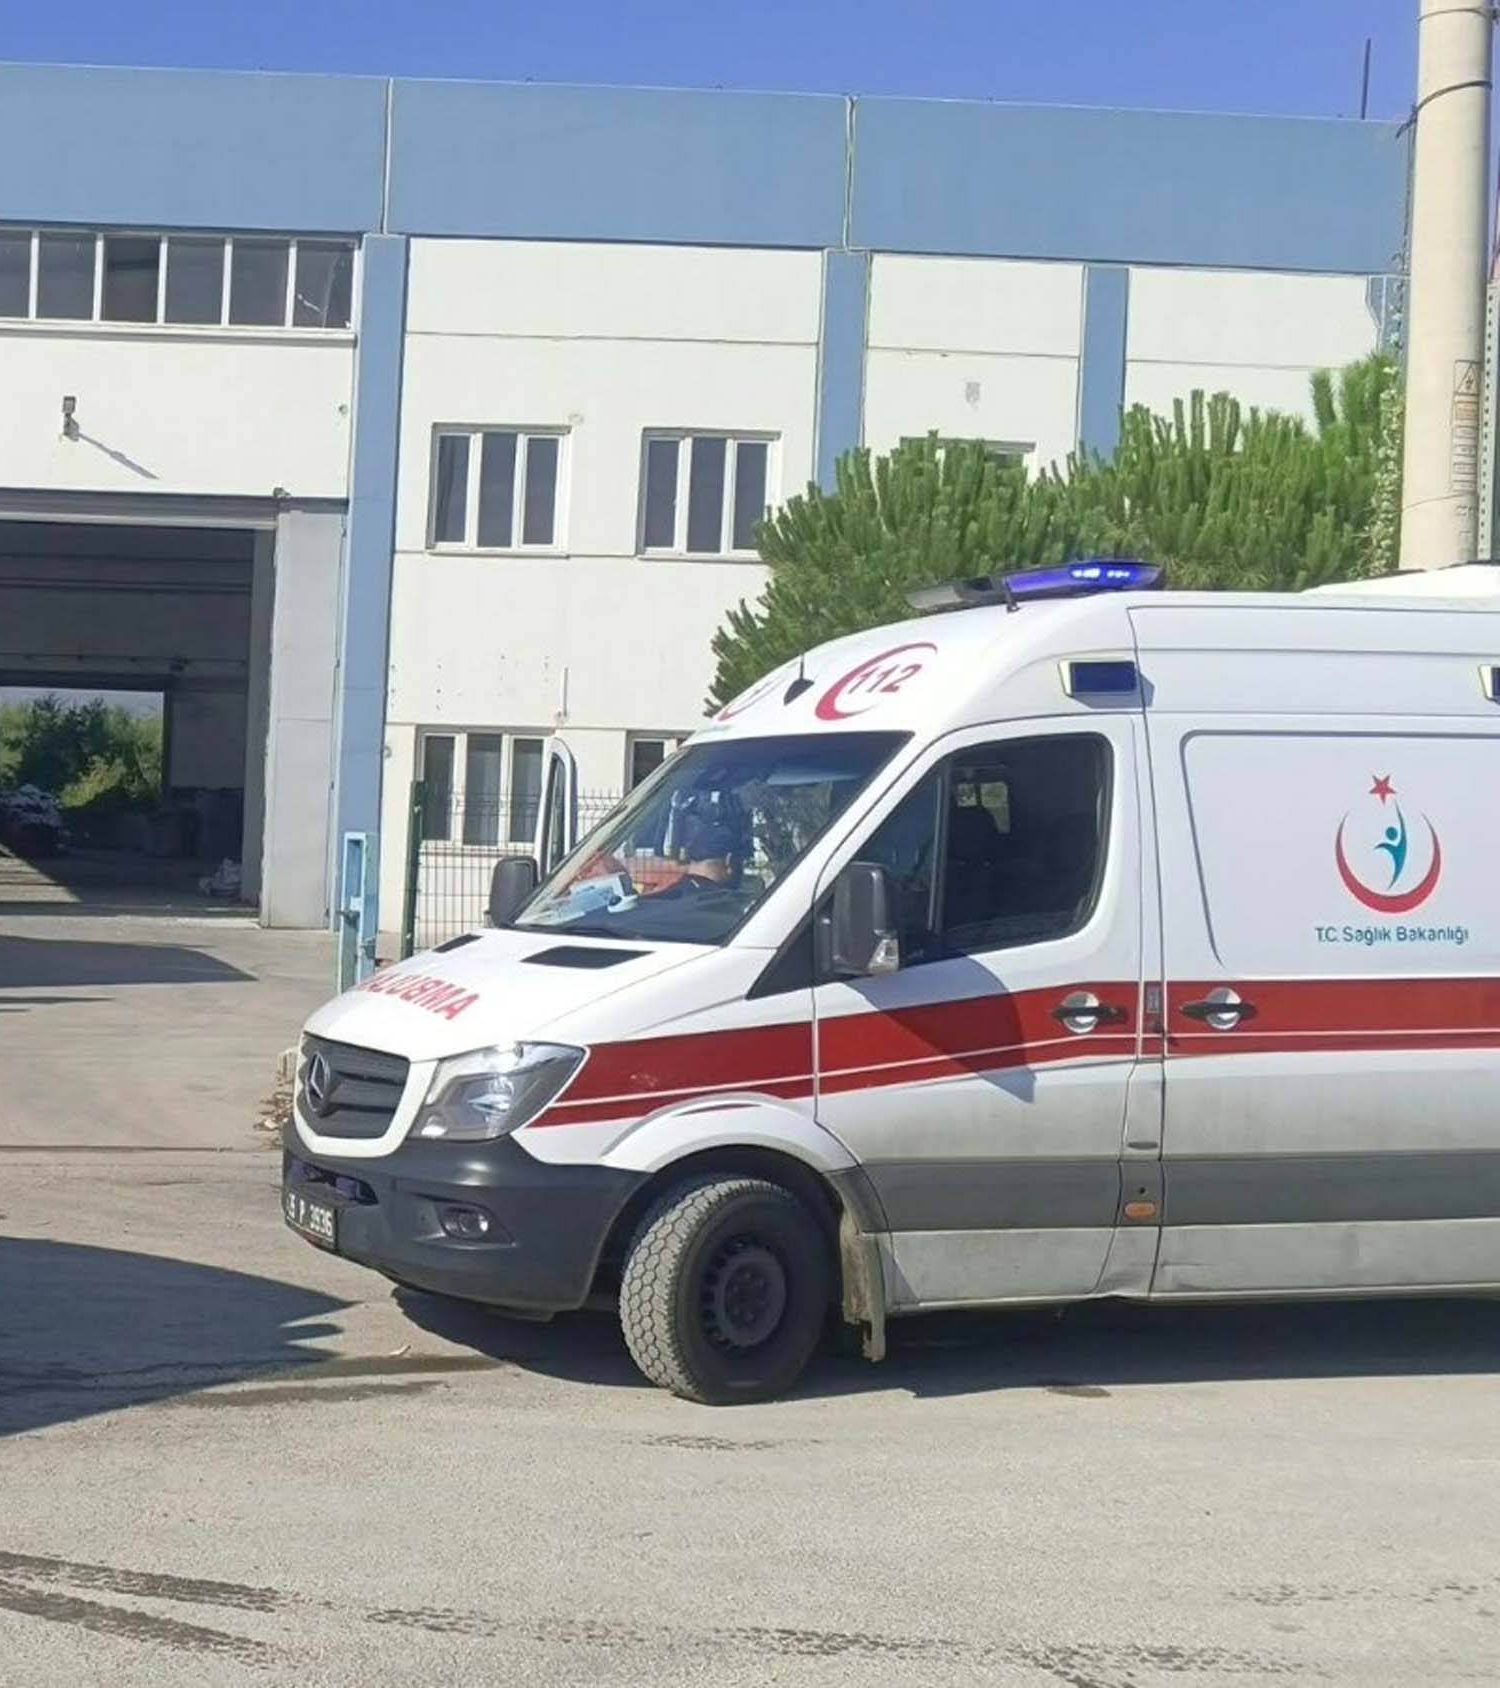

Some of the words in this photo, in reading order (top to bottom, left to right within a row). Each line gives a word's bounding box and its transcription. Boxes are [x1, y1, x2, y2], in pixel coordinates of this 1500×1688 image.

[848, 663, 923, 695] 112
[1343, 926, 1391, 946] Sağlık
[1396, 926, 1469, 945] Bakanlığı
